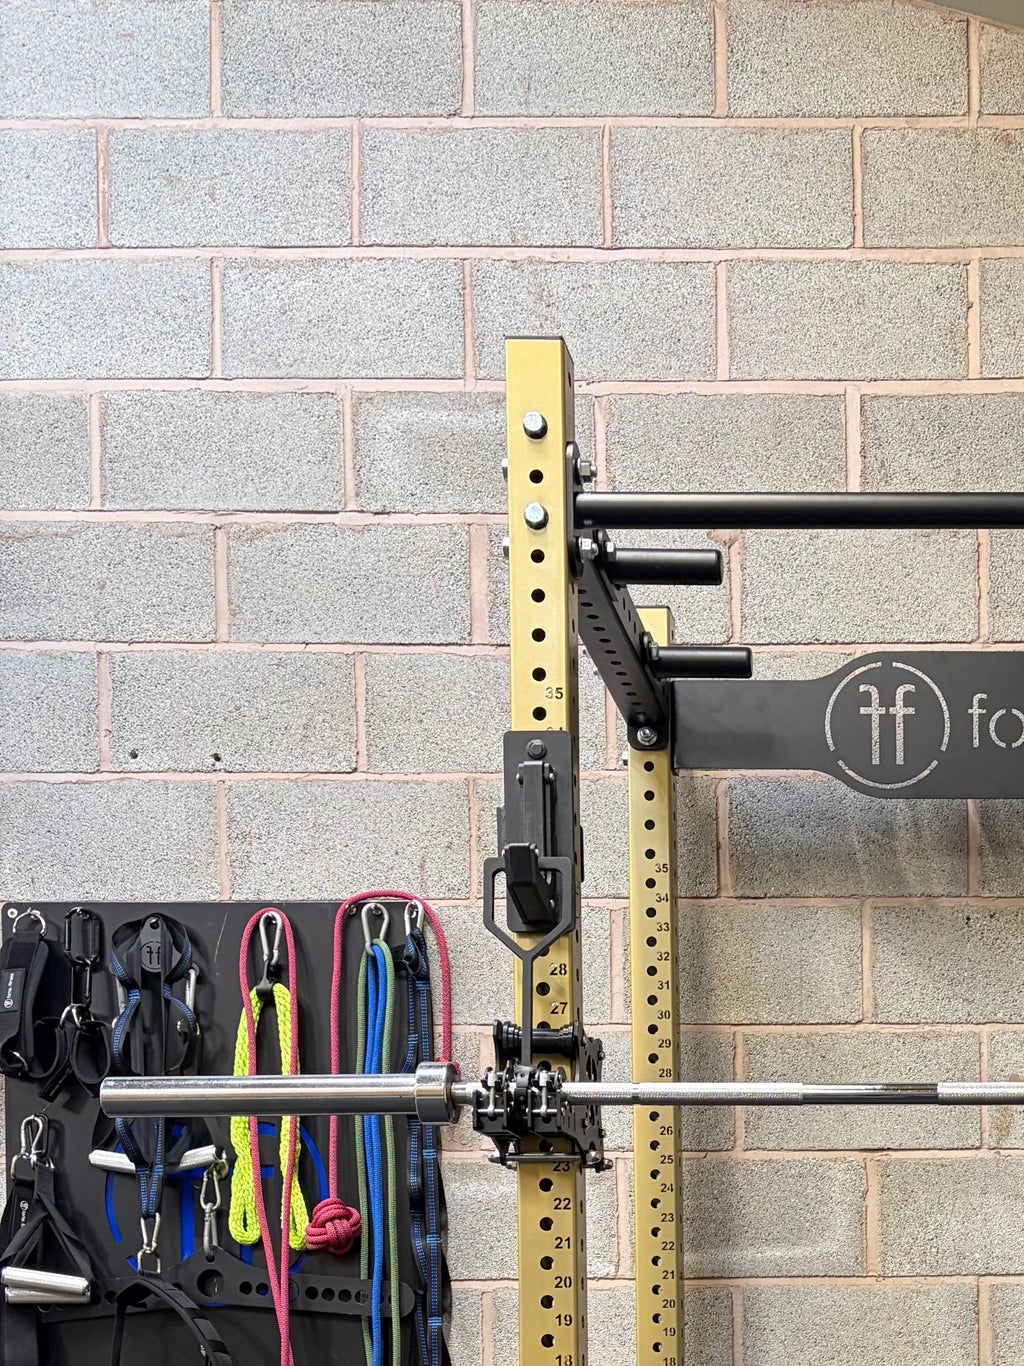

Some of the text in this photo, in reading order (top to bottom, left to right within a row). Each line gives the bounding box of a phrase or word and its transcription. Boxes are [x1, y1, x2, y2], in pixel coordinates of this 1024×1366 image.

[545, 686, 564, 701] 35
[548, 962, 568, 977] 28
[548, 1000, 569, 1015] 27
[552, 1161, 572, 1173] 23
[552, 1197, 572, 1211] 22
[554, 1236, 571, 1250] 21
[553, 1275, 573, 1289] 20
[554, 1313, 573, 1327] 19
